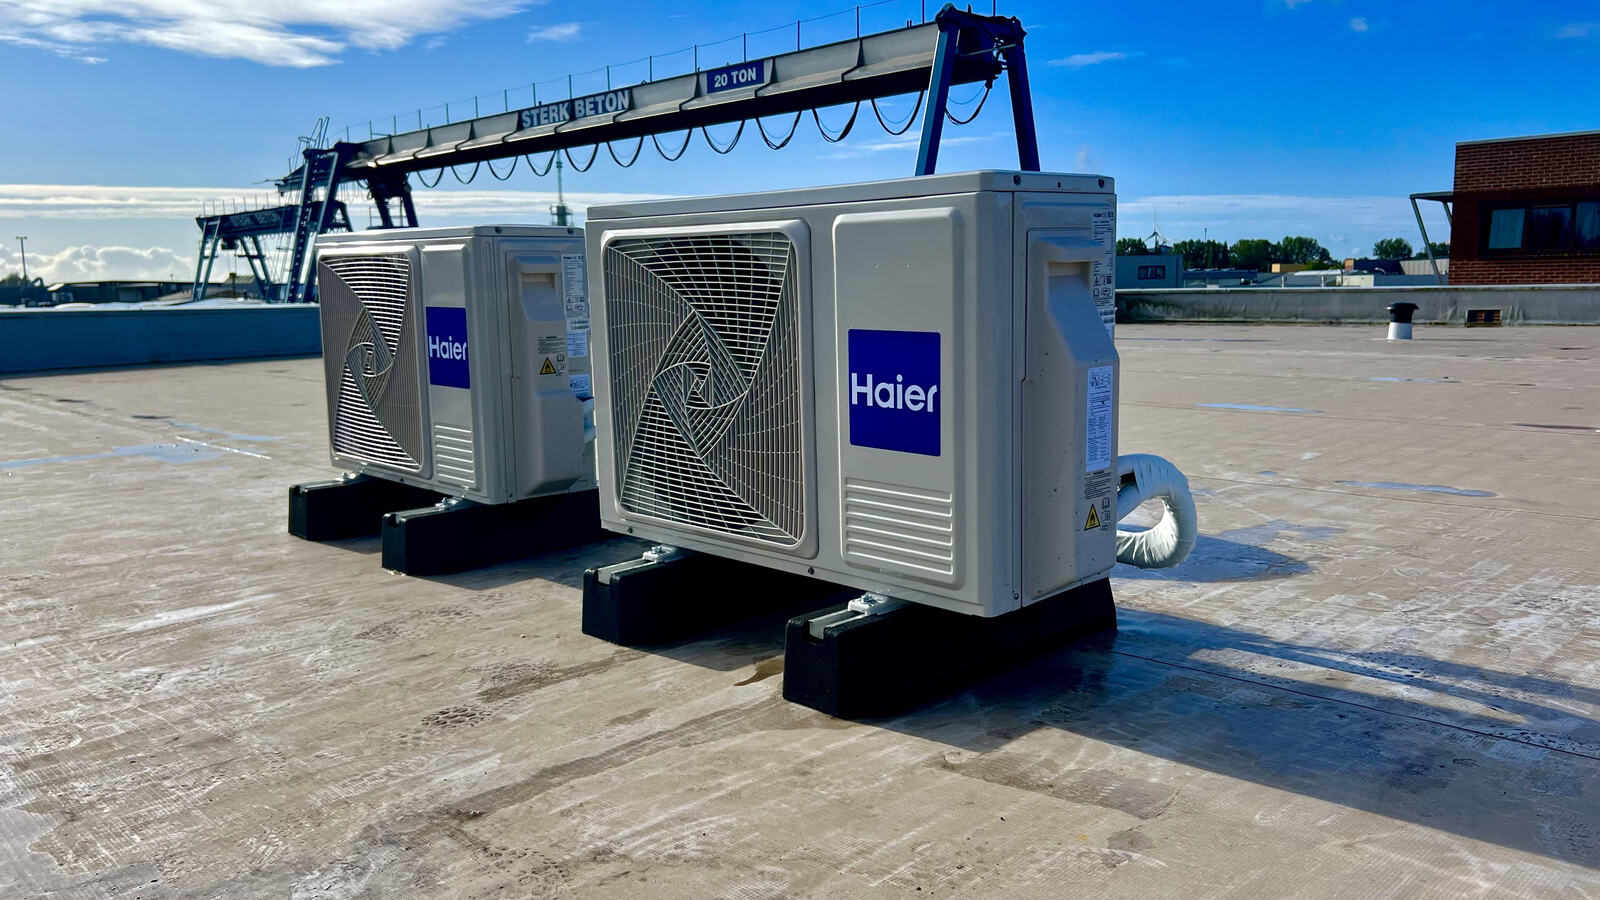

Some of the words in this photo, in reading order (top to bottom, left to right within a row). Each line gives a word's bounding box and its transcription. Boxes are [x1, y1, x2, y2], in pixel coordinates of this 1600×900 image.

[714, 73, 728, 88] 20
[731, 67, 756, 84] TON
[521, 102, 570, 128] STERK
[574, 90, 630, 118] BETON
[428, 335, 467, 361] Haier
[851, 372, 938, 413] Haier
